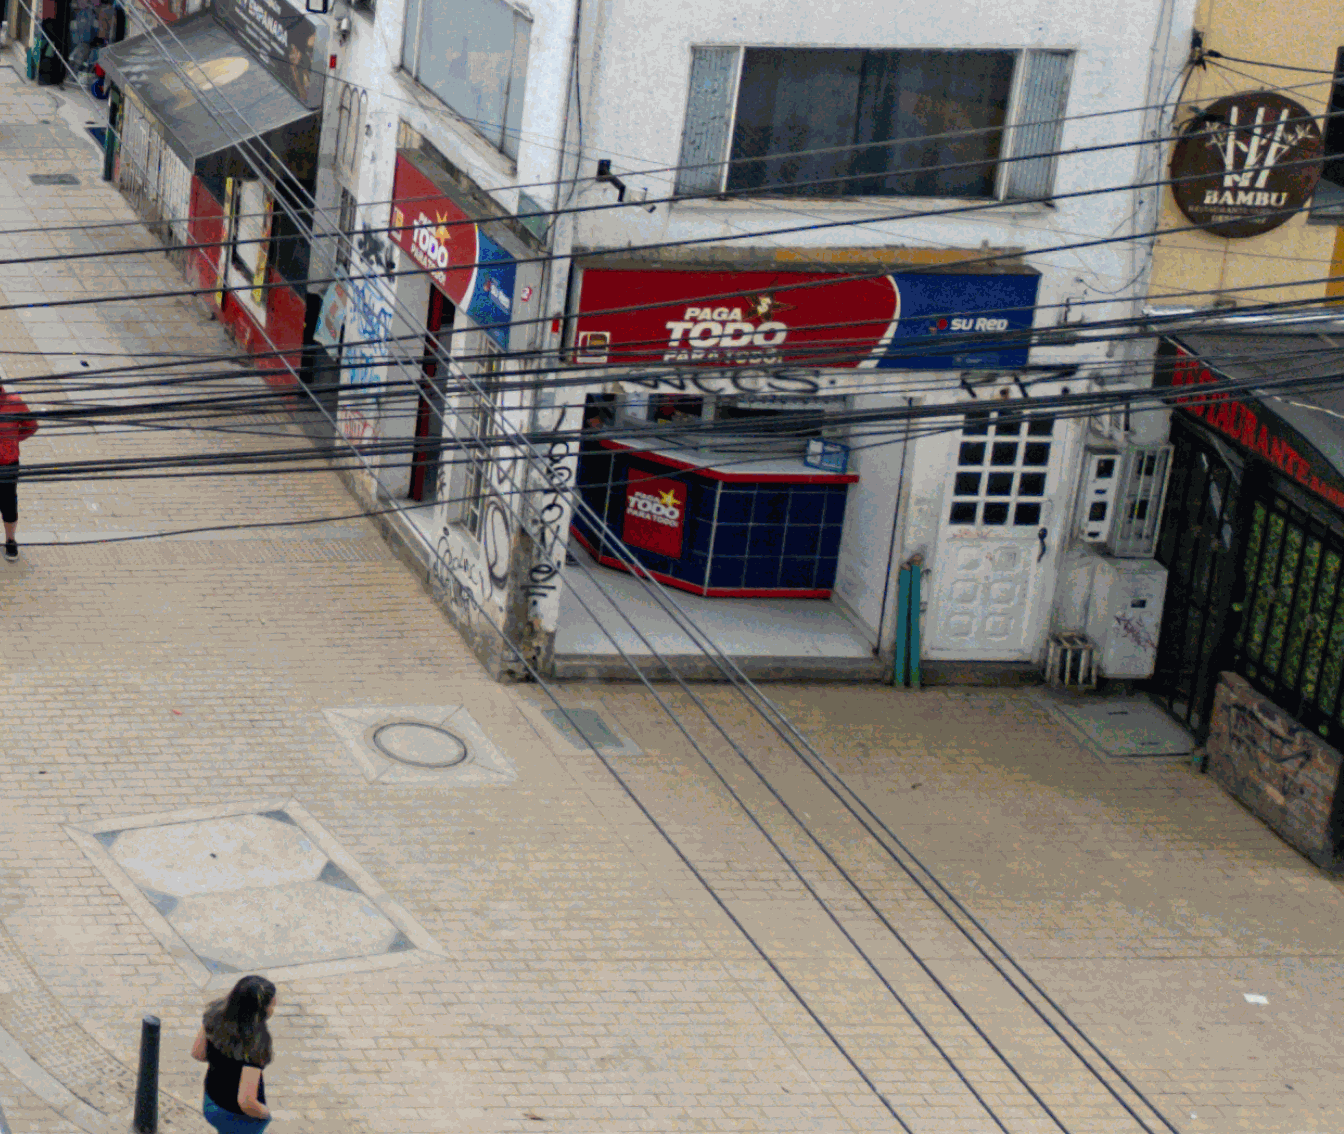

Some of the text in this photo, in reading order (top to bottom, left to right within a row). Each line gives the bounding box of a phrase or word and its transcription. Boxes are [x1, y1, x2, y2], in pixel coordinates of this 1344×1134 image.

[1203, 189, 1289, 207] BAMBU
[413, 219, 448, 268] TODO
[684, 307, 743, 321] PAGA
[665, 321, 788, 348] TODO
[627, 495, 680, 520] TODO
